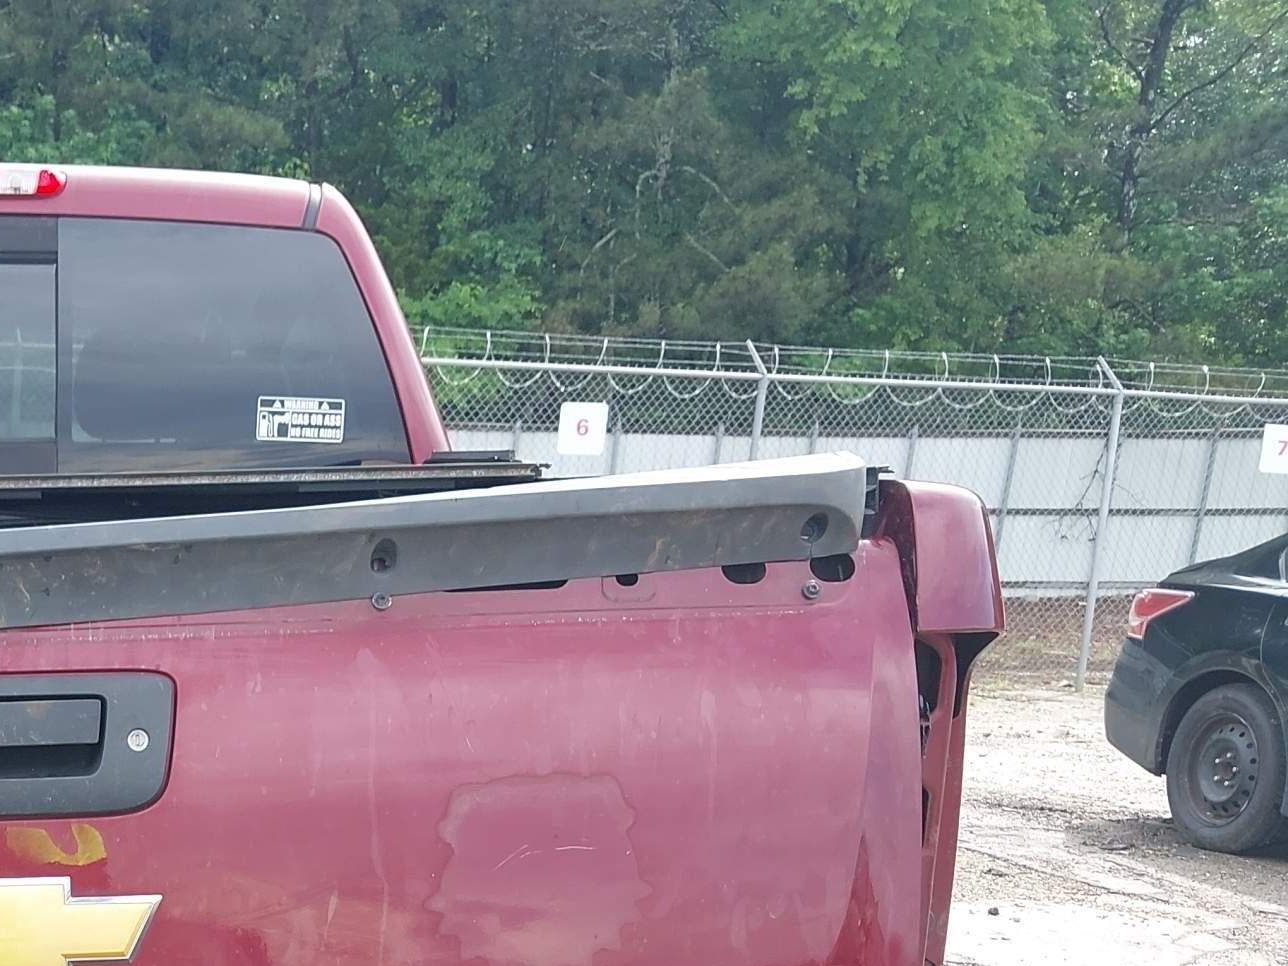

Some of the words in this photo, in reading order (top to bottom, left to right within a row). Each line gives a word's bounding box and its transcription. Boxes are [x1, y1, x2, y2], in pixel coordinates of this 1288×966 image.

[283, 399, 320, 410] WARNING
[291, 413, 310, 426] GAS
[310, 413, 324, 427] OR
[323, 413, 342, 427] ASS
[290, 426, 302, 437] NO
[576, 418, 589, 437] 6
[1277, 439, 1288, 456] 7
